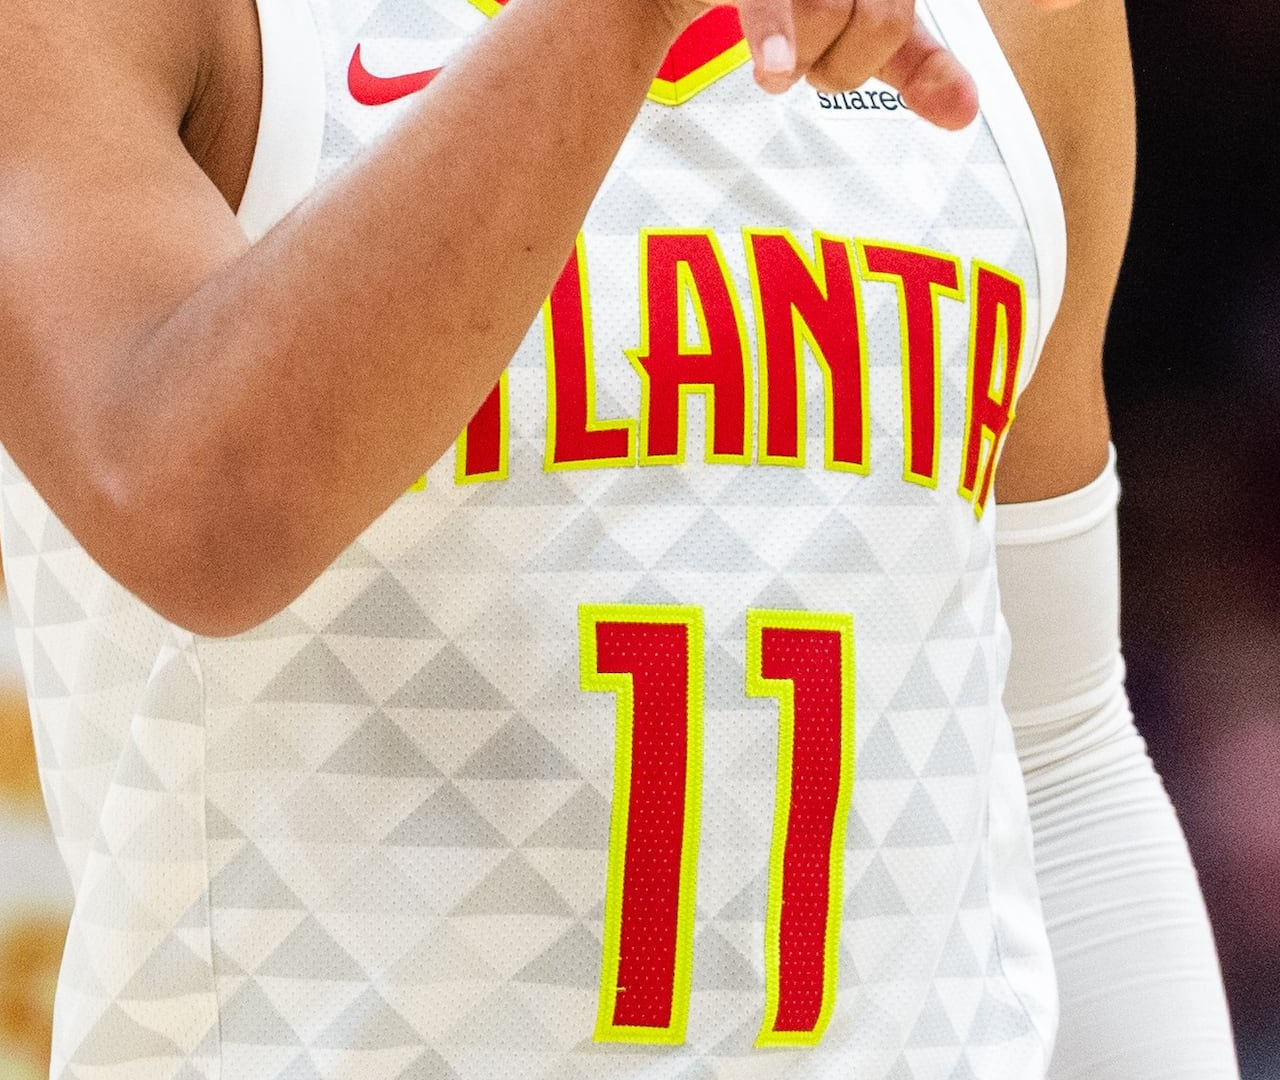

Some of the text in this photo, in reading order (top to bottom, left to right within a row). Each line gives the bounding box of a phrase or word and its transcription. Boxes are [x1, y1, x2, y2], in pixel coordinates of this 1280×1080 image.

[817, 90, 908, 111] sare
[407, 227, 1026, 522] LANTA
[578, 603, 855, 1047] 11
